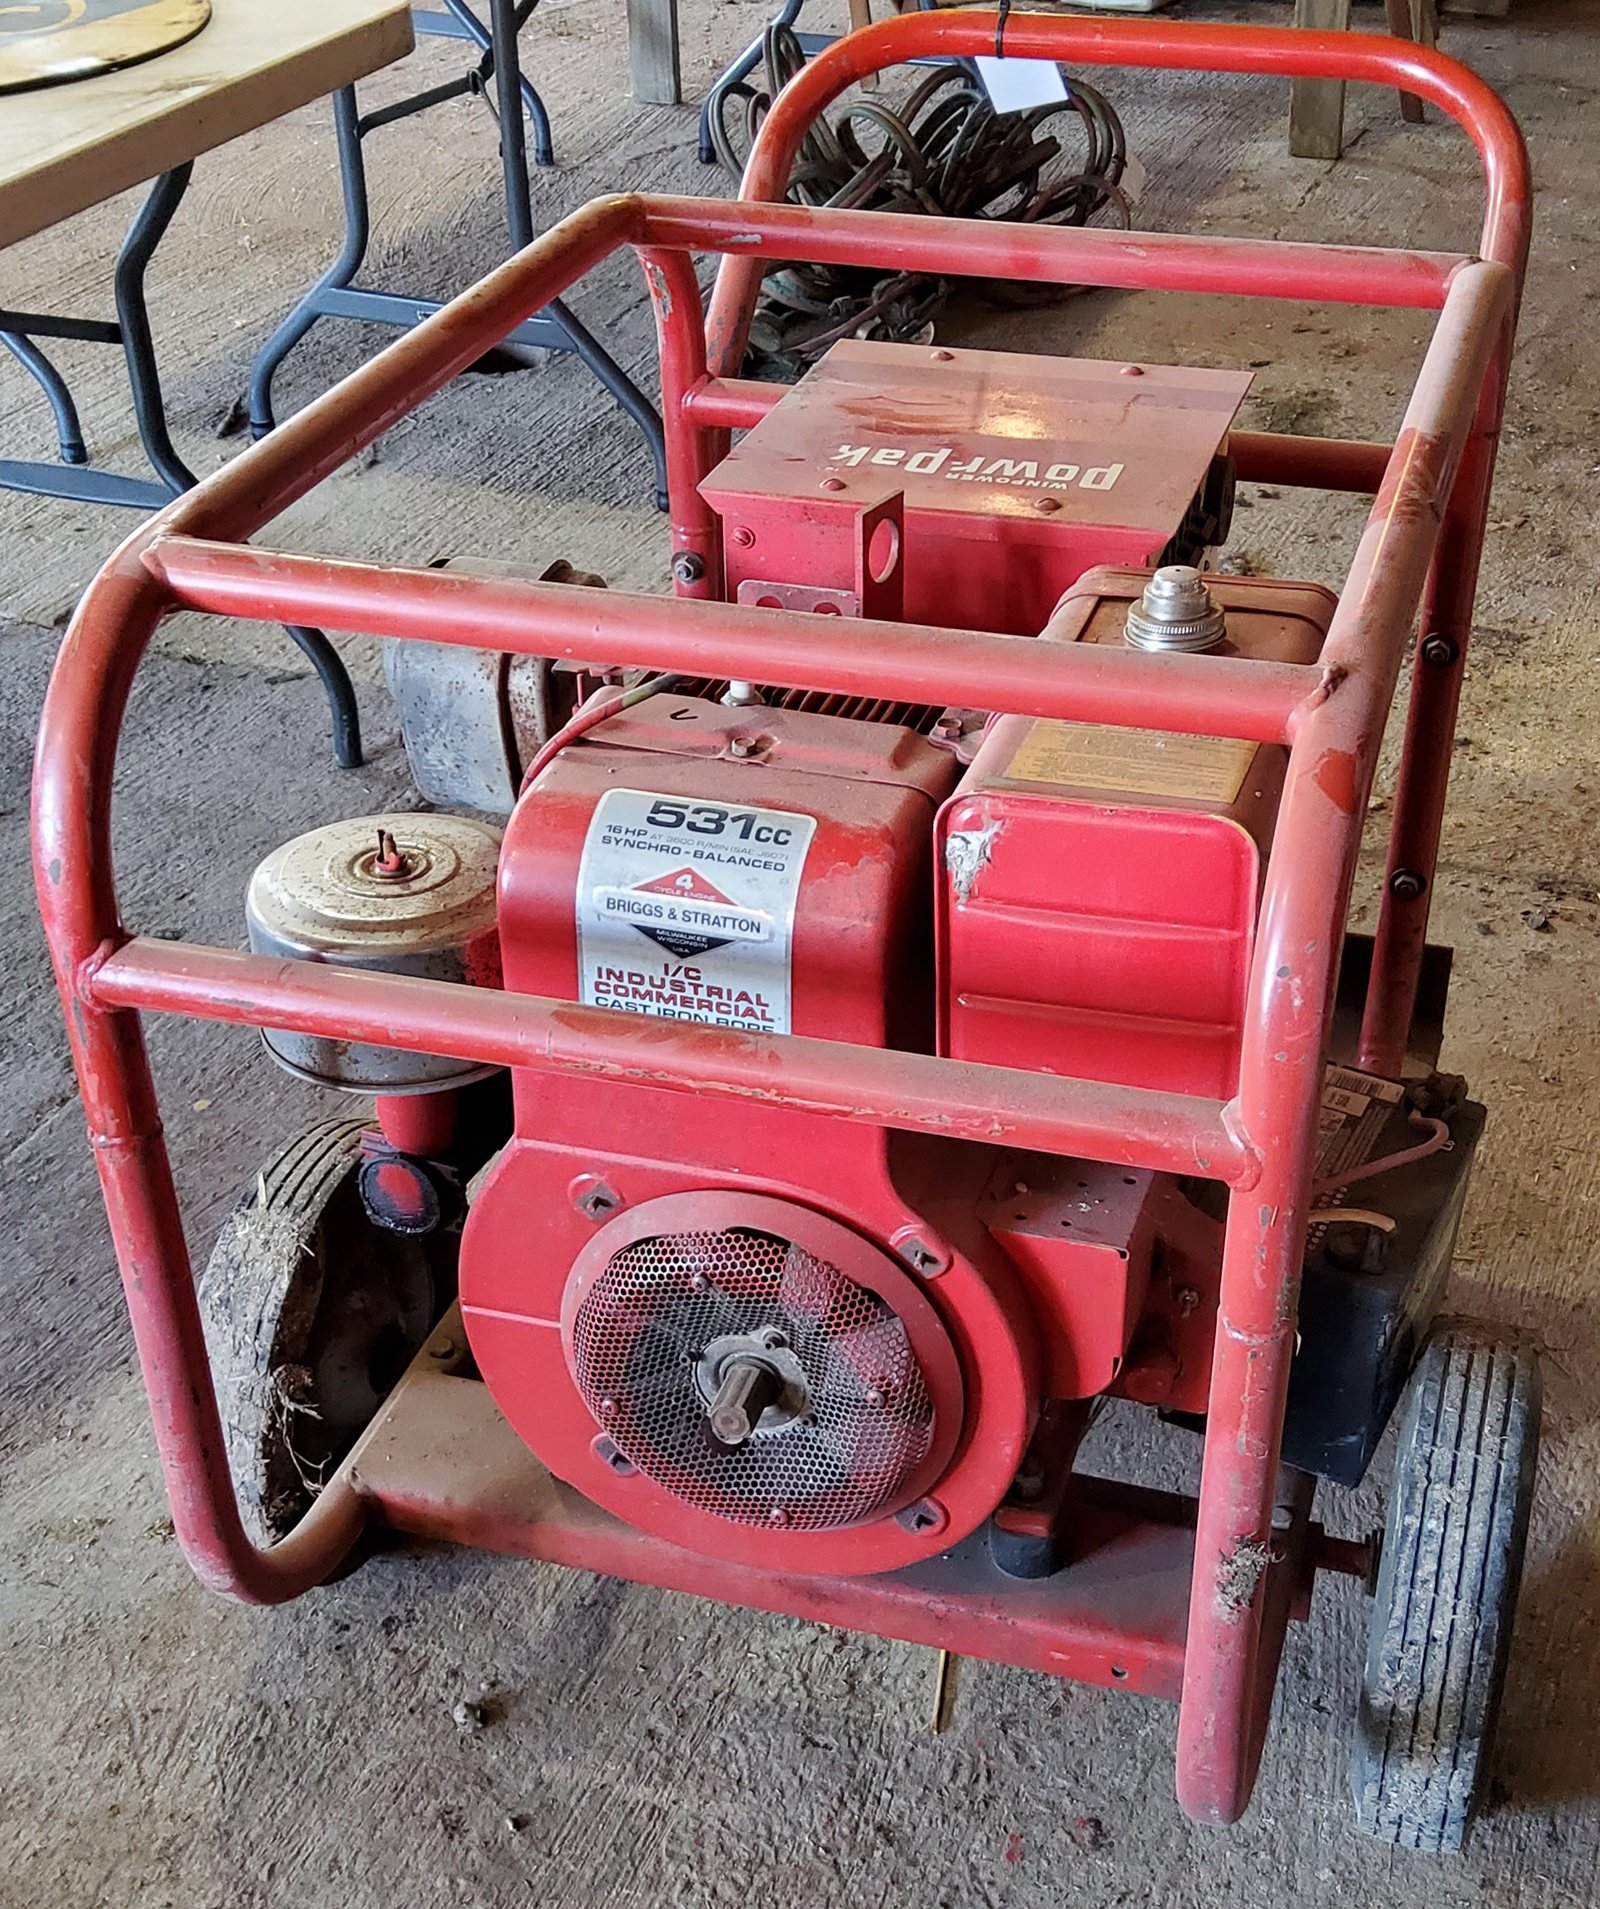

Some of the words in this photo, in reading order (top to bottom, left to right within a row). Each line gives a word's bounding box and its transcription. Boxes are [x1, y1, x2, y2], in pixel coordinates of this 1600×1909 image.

[945, 472, 1067, 490] WINPOWER
[606, 824, 623, 834] 16
[624, 827, 648, 837] HP
[675, 873, 694, 890] 4
[653, 886, 681, 895] CYCLE
[684, 890, 717, 902] ENGINE
[606, 897, 663, 918] BRIGGS
[667, 907, 678, 921] &
[681, 910, 761, 934] STRATTON
[656, 929, 708, 943] MILWAUKEE
[657, 935, 709, 949] WISCONSIN
[664, 962, 702, 981] I/C
[597, 966, 770, 1008] INDUSTRIAL
[594, 980, 775, 1022] COMMERCIAL
[595, 996, 651, 1014] CAST
[657, 1007, 709, 1024] IRON
